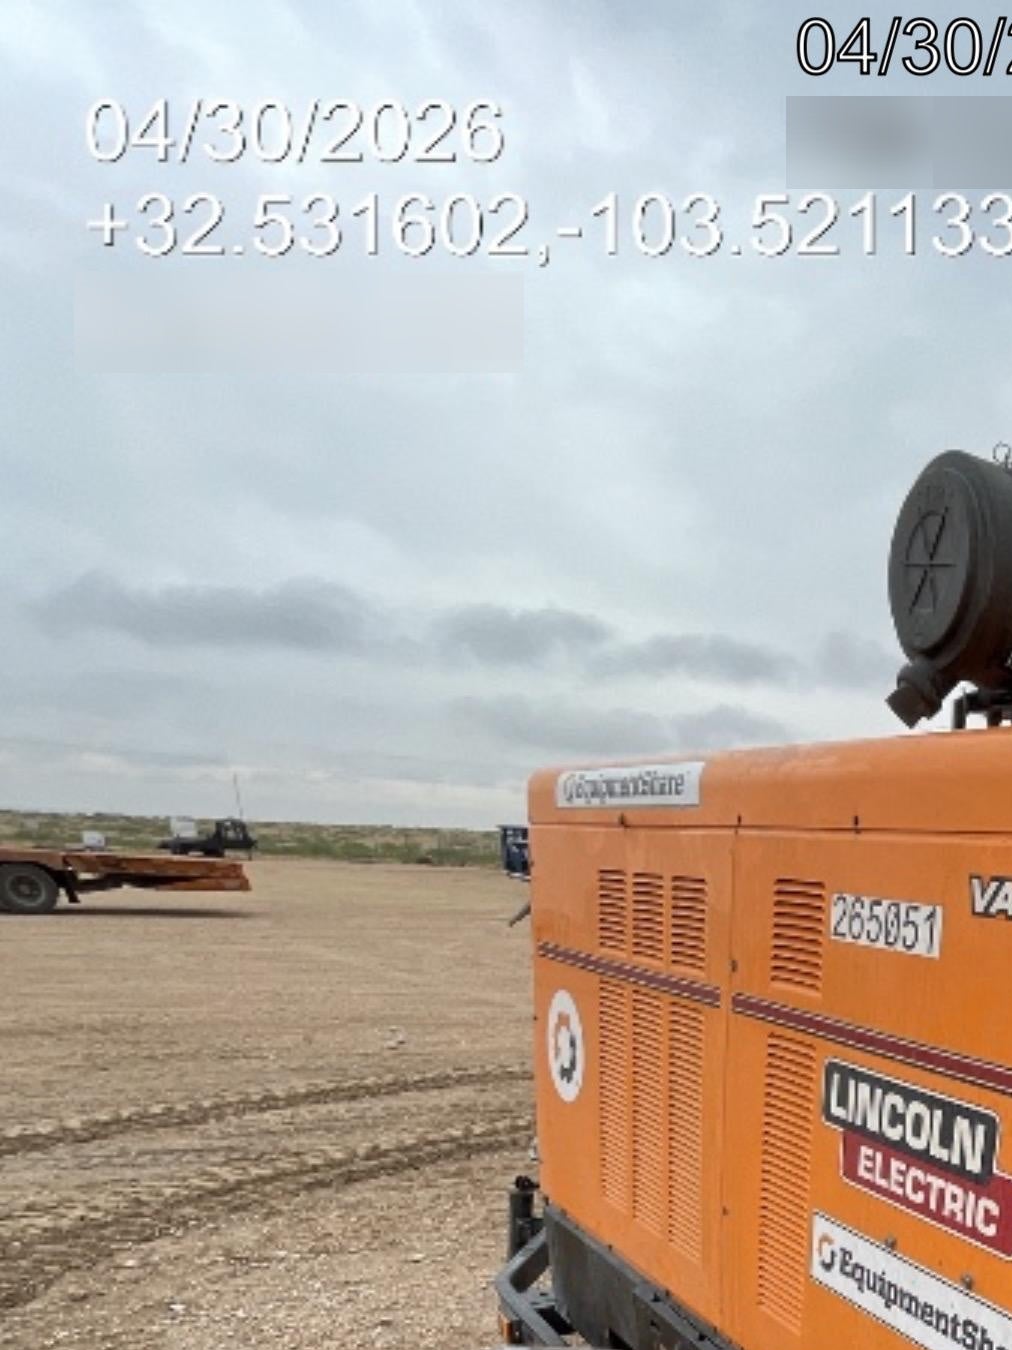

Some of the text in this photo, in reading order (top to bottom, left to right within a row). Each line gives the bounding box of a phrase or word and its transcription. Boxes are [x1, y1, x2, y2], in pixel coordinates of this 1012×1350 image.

[833, 896, 937, 954] 265051
[830, 1073, 986, 1174] LINCOLN
[857, 1145, 1000, 1238] ELECTRIC
